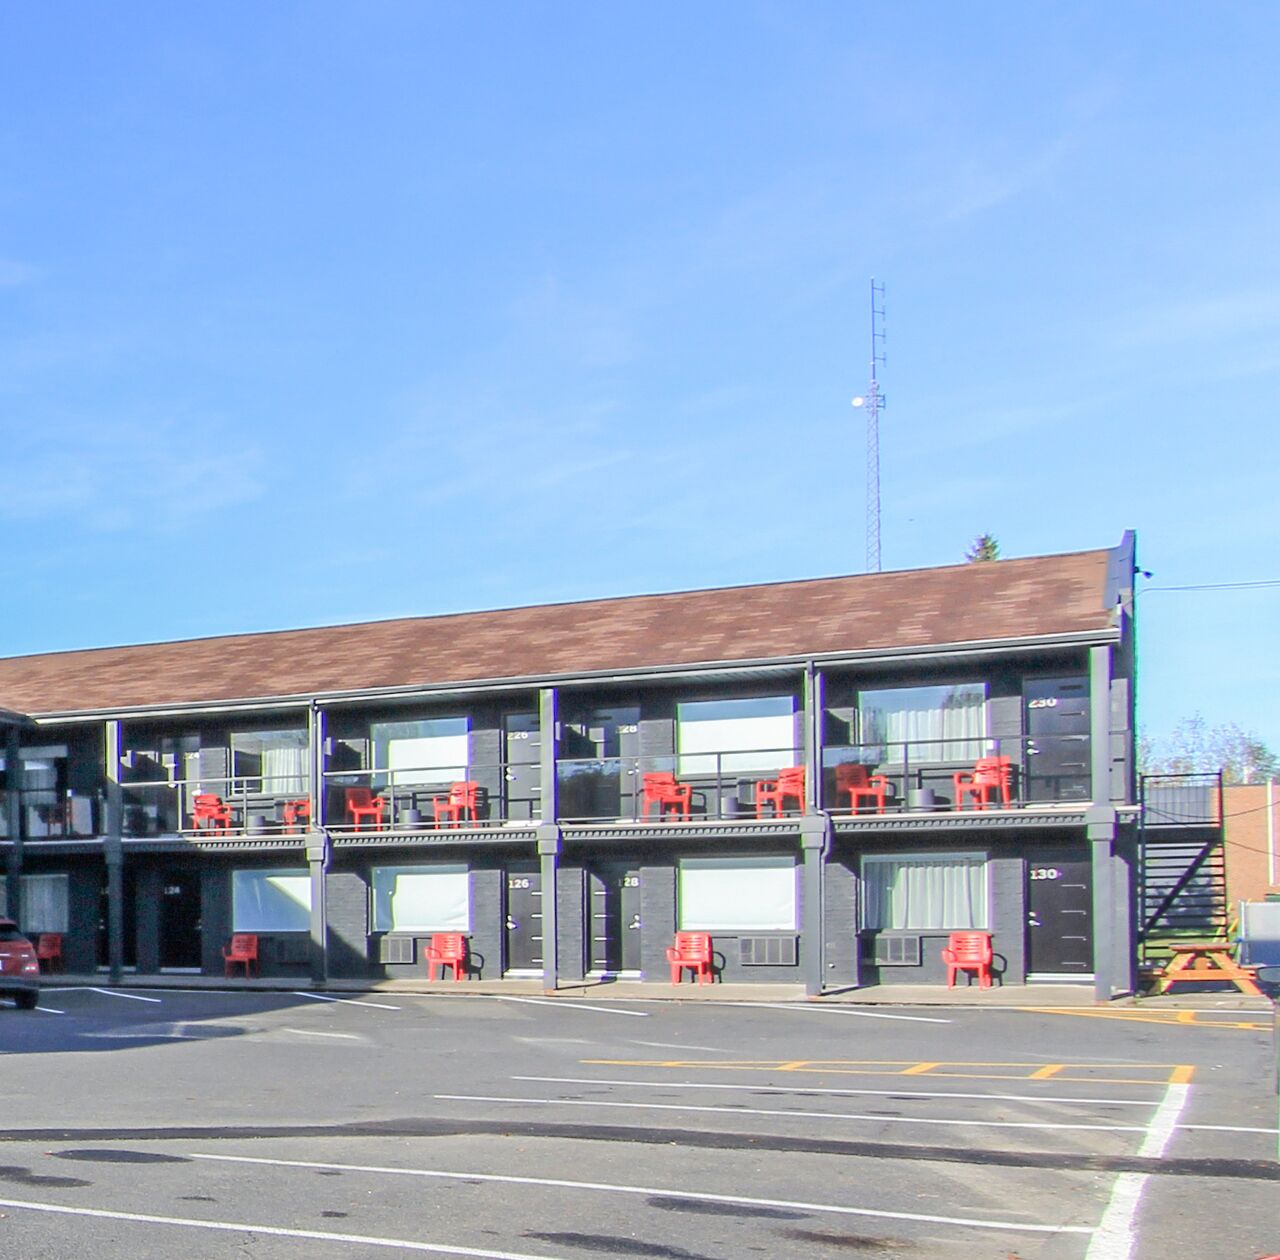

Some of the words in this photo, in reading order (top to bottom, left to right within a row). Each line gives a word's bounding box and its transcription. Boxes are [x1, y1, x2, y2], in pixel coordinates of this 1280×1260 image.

[1028, 698, 1057, 708] 230
[507, 731, 528, 740] 226
[1030, 868, 1058, 880] 130
[508, 879, 530, 889] 126
[618, 877, 640, 887] 128
